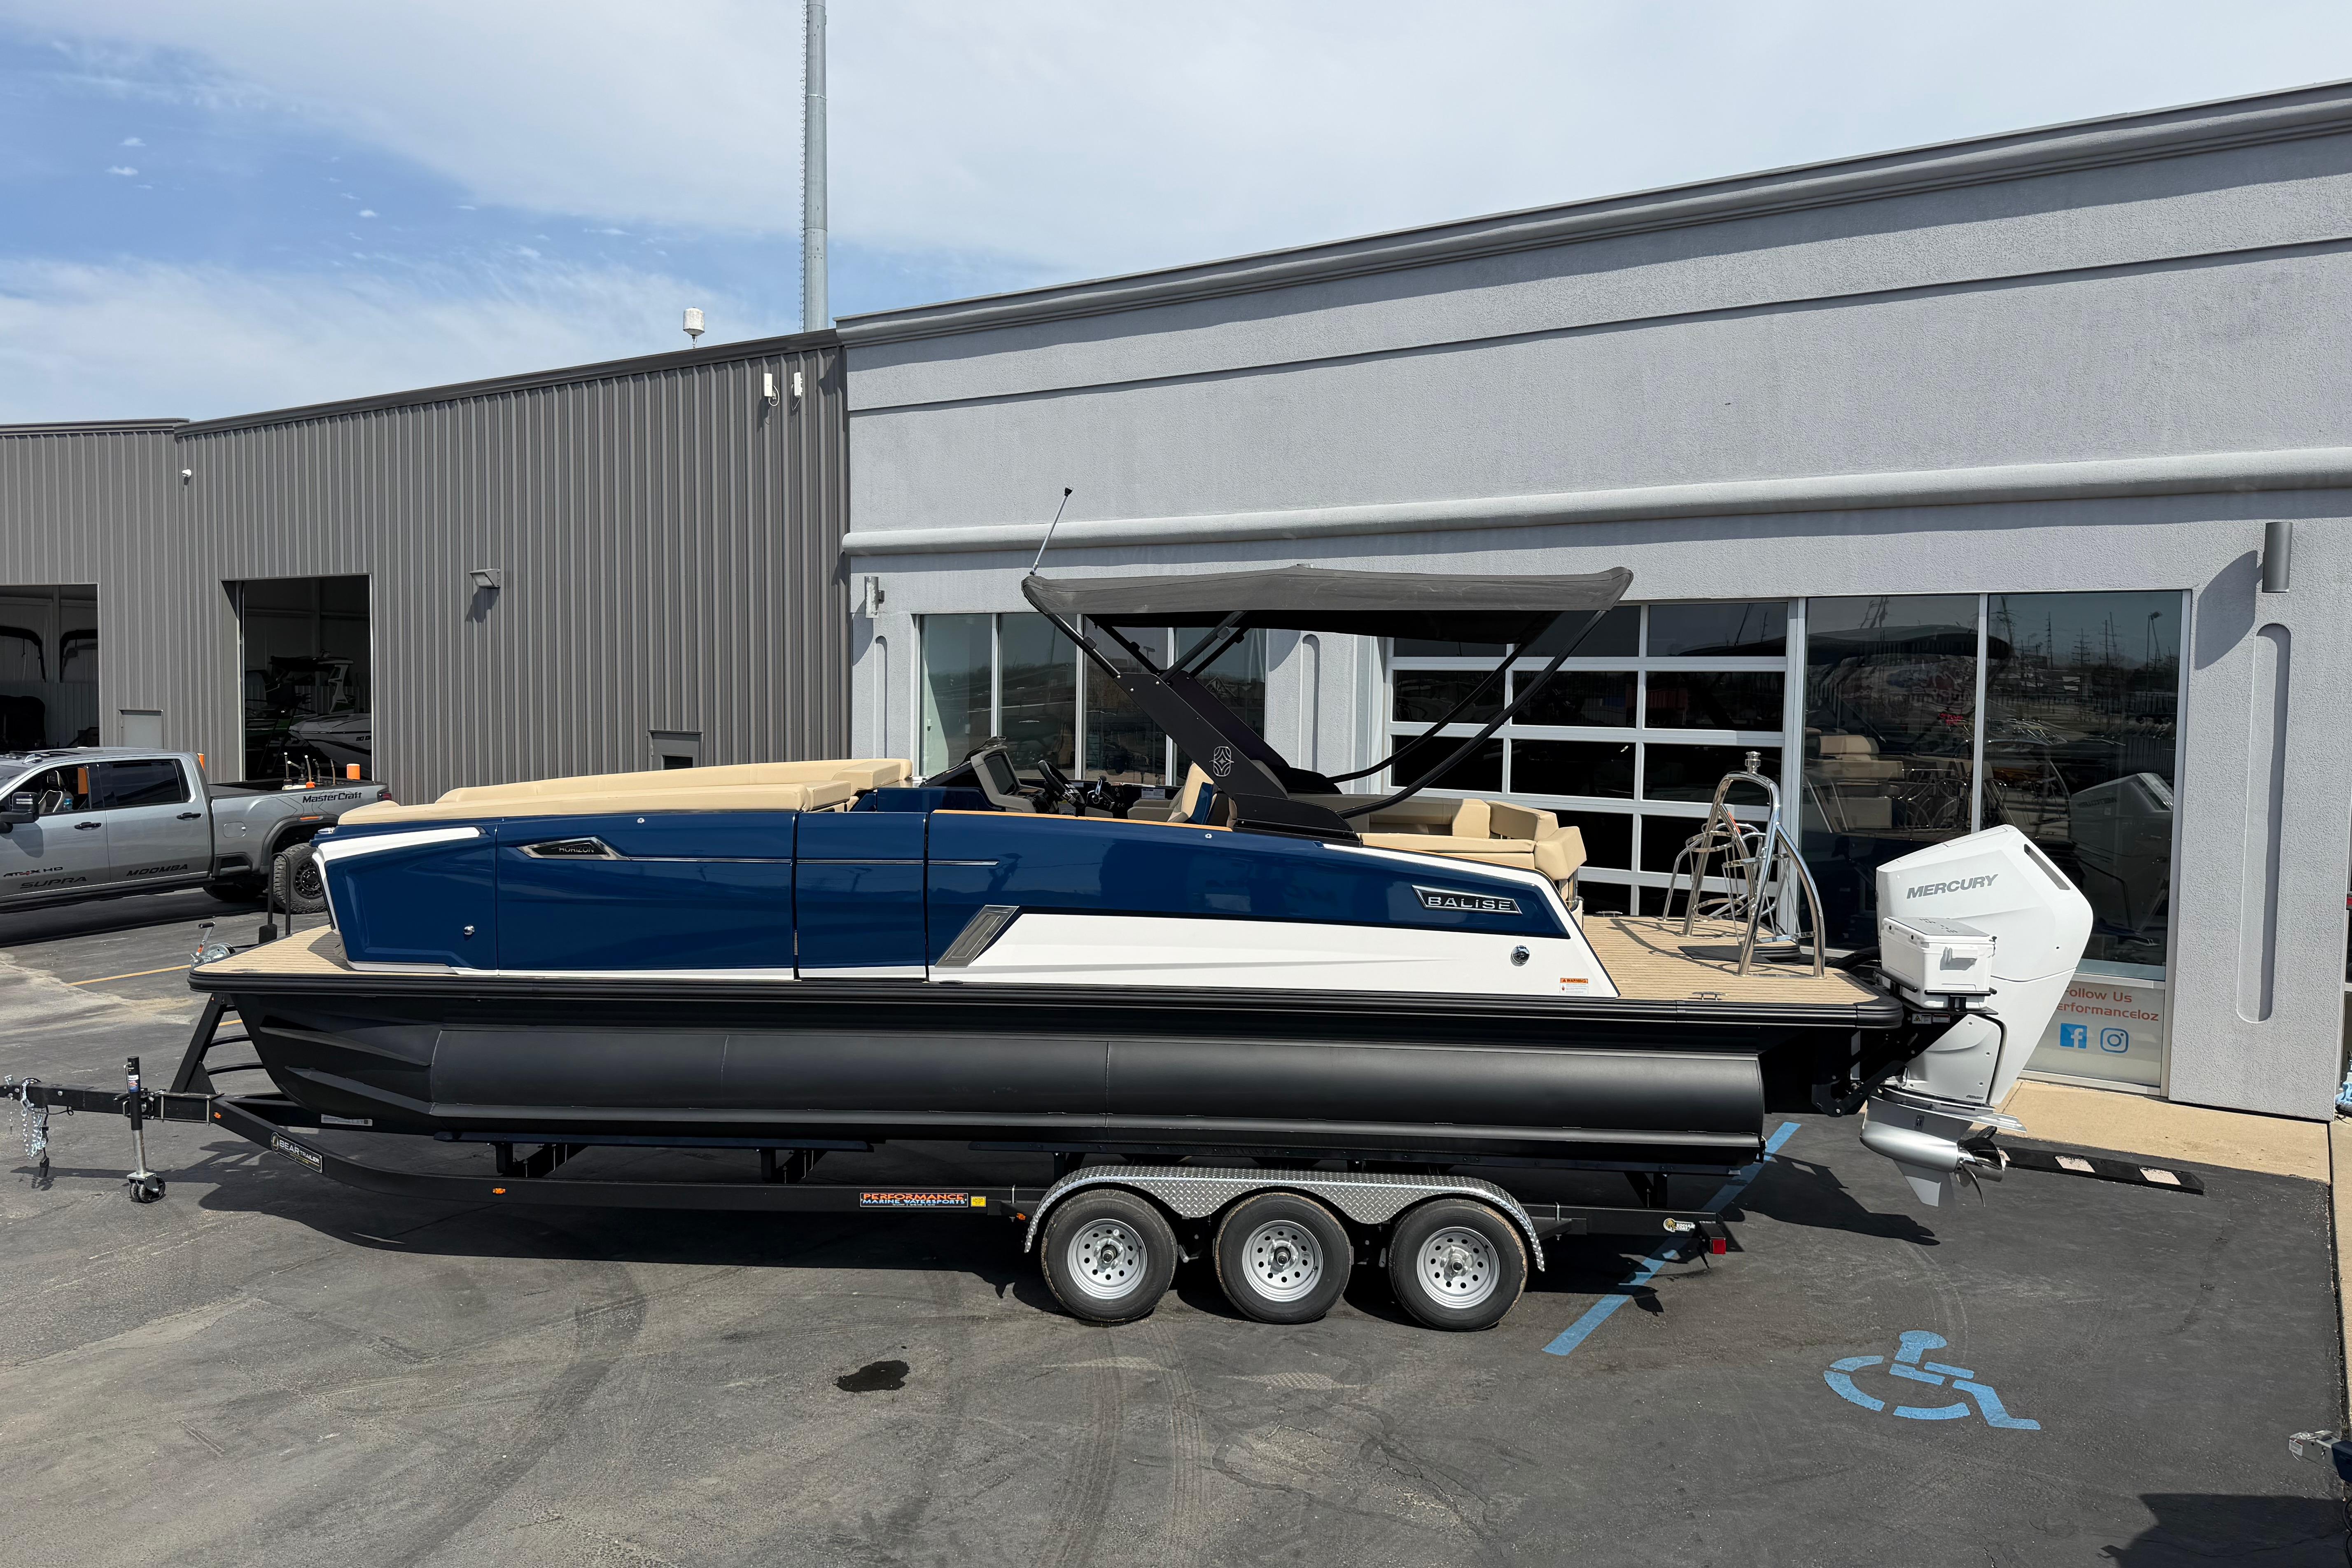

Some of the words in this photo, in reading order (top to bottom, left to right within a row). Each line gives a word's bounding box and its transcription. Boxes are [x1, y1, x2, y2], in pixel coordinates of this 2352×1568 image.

[302, 792, 362, 803] MasterCraft
[126, 864, 188, 877] MOOMBA
[19, 876, 87, 889] SUPRA
[1906, 874, 1998, 899] MERCURY
[1428, 896, 1511, 911] BALISE
[2113, 992, 2132, 1003] Us
[280, 1140, 299, 1155] BEAR
[300, 1150, 320, 1163] TRAILER
